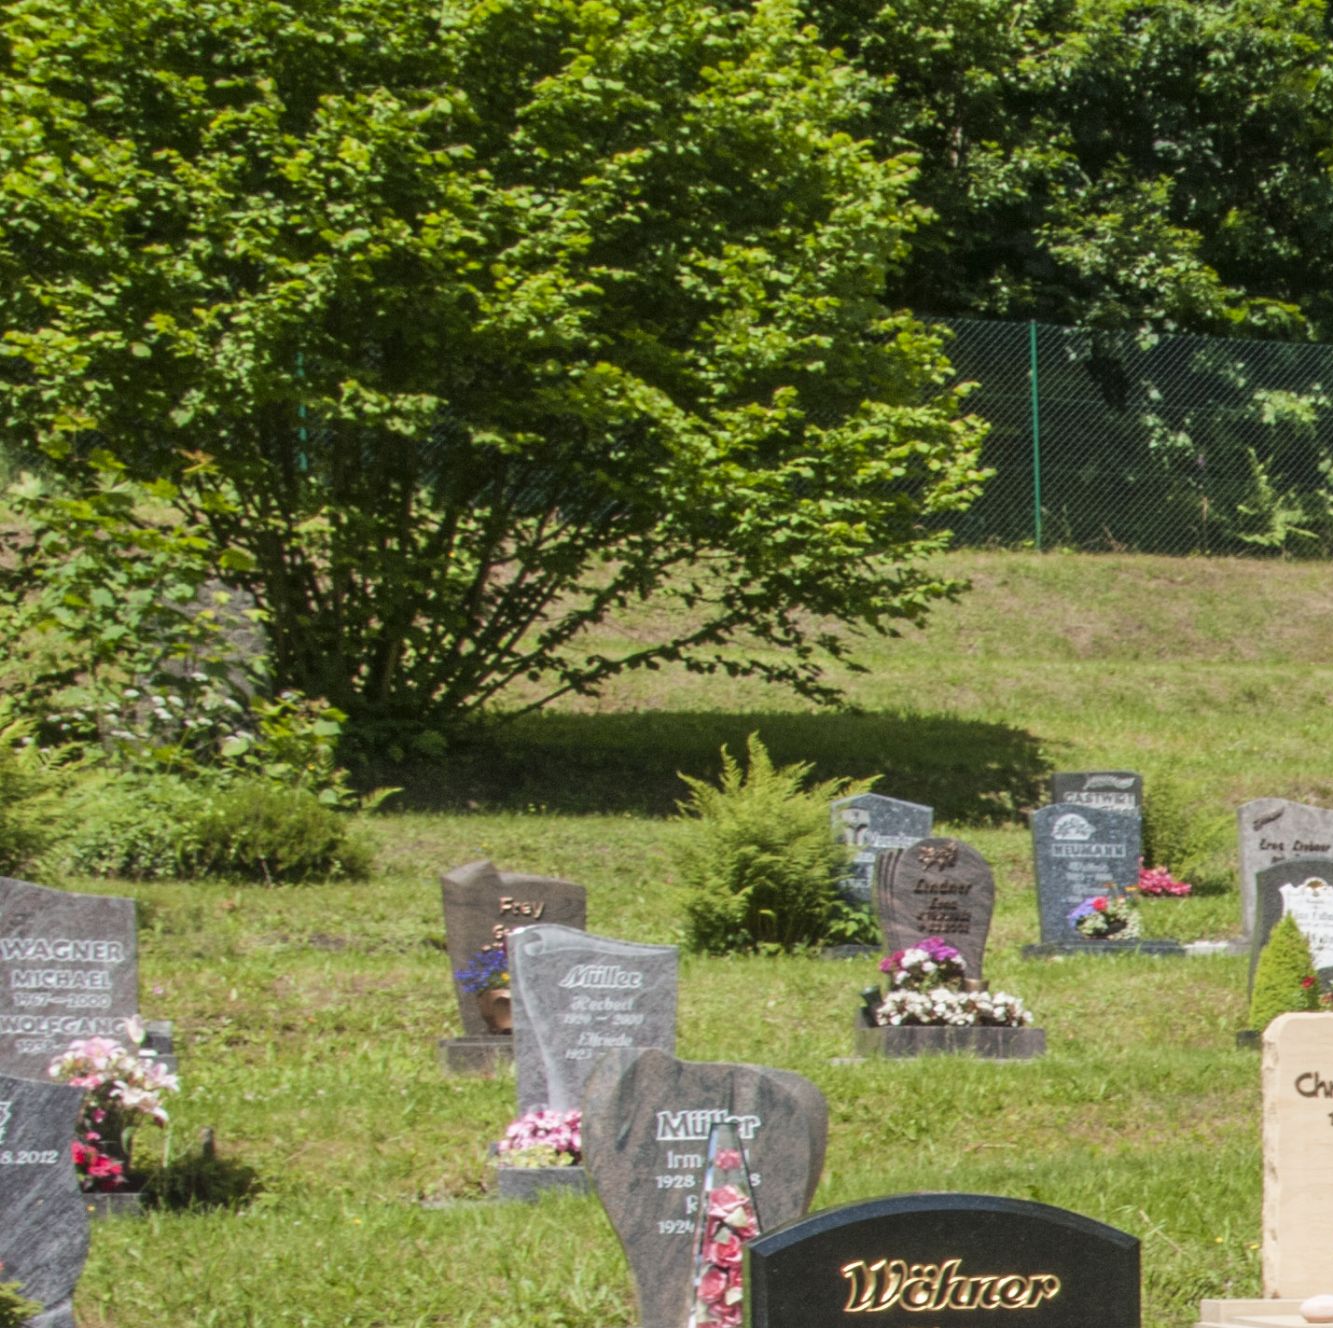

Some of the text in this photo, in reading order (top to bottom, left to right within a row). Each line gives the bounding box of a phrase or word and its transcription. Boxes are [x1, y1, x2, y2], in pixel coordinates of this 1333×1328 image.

[2, 938, 125, 962] WAGNER
[11, 969, 112, 989] MICHAEL
[558, 963, 642, 989] Müller
[0, 1014, 128, 1036] WOLFGANG
